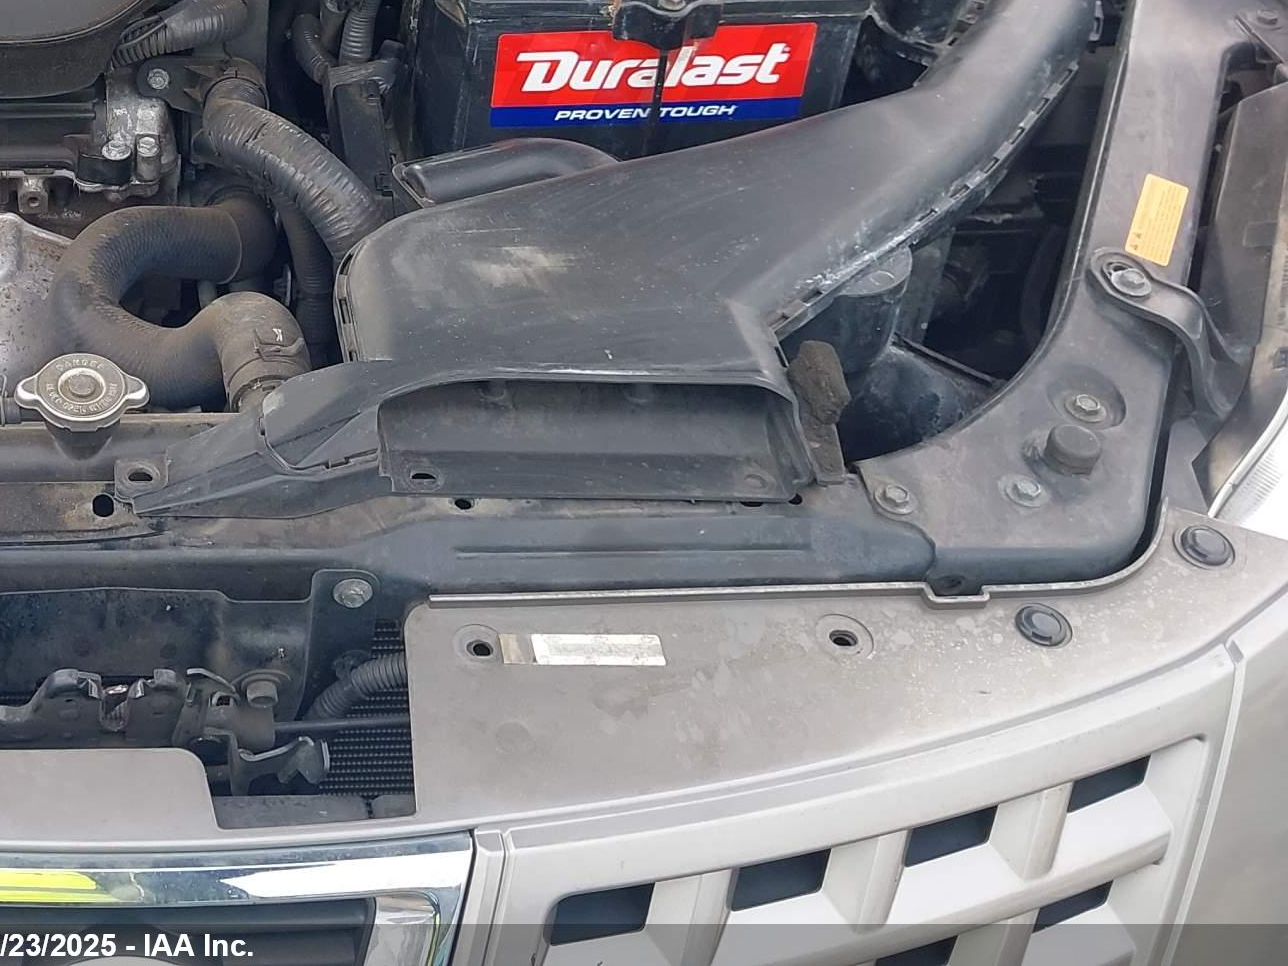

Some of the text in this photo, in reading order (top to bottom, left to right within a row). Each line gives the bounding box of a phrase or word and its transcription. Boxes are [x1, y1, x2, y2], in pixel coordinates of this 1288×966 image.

[516, 43, 790, 92] Duralast
[554, 104, 735, 121] PROVEN TOUGH
